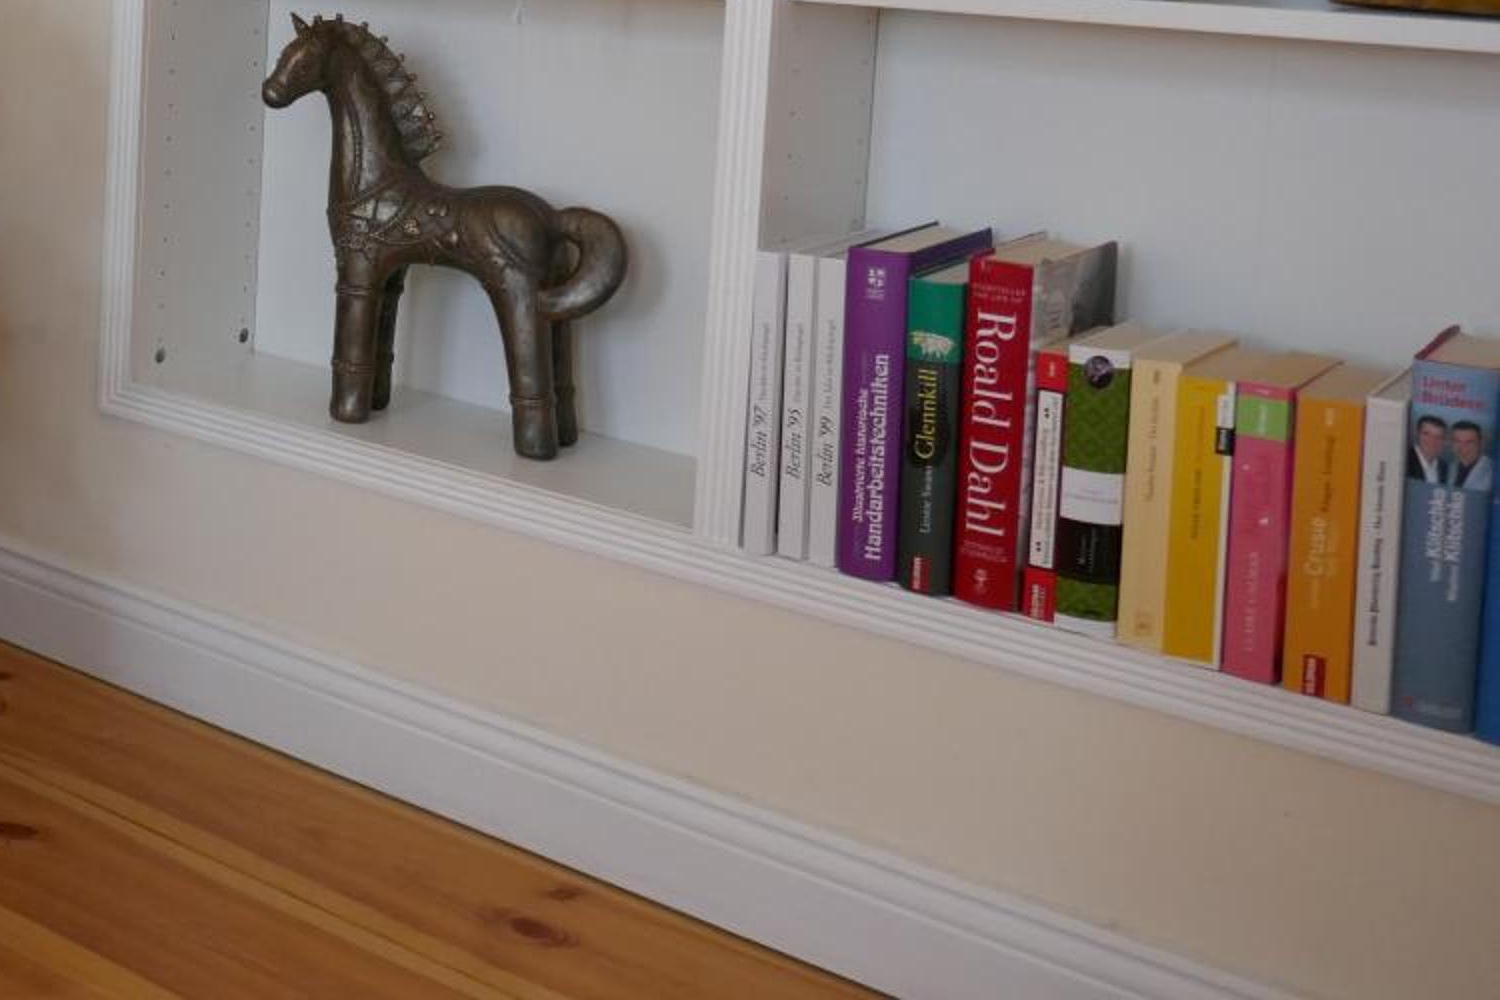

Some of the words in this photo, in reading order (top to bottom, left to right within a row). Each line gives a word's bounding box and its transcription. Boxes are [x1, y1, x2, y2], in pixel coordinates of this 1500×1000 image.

[971, 309, 1016, 428] Roald
[752, 406, 767, 427] '97
[787, 409, 801, 428] '95
[818, 416, 833, 438] '99
[914, 368, 939, 459] Glennkill
[750, 432, 767, 476] Berlin
[786, 432, 802, 479] Berlin
[816, 443, 833, 486] Berlin
[863, 354, 891, 560] Handarbeitstechniken
[851, 457, 866, 523] Illustrierte
[965, 439, 1009, 537] Dahl
[1426, 487, 1446, 558] Klitschko
